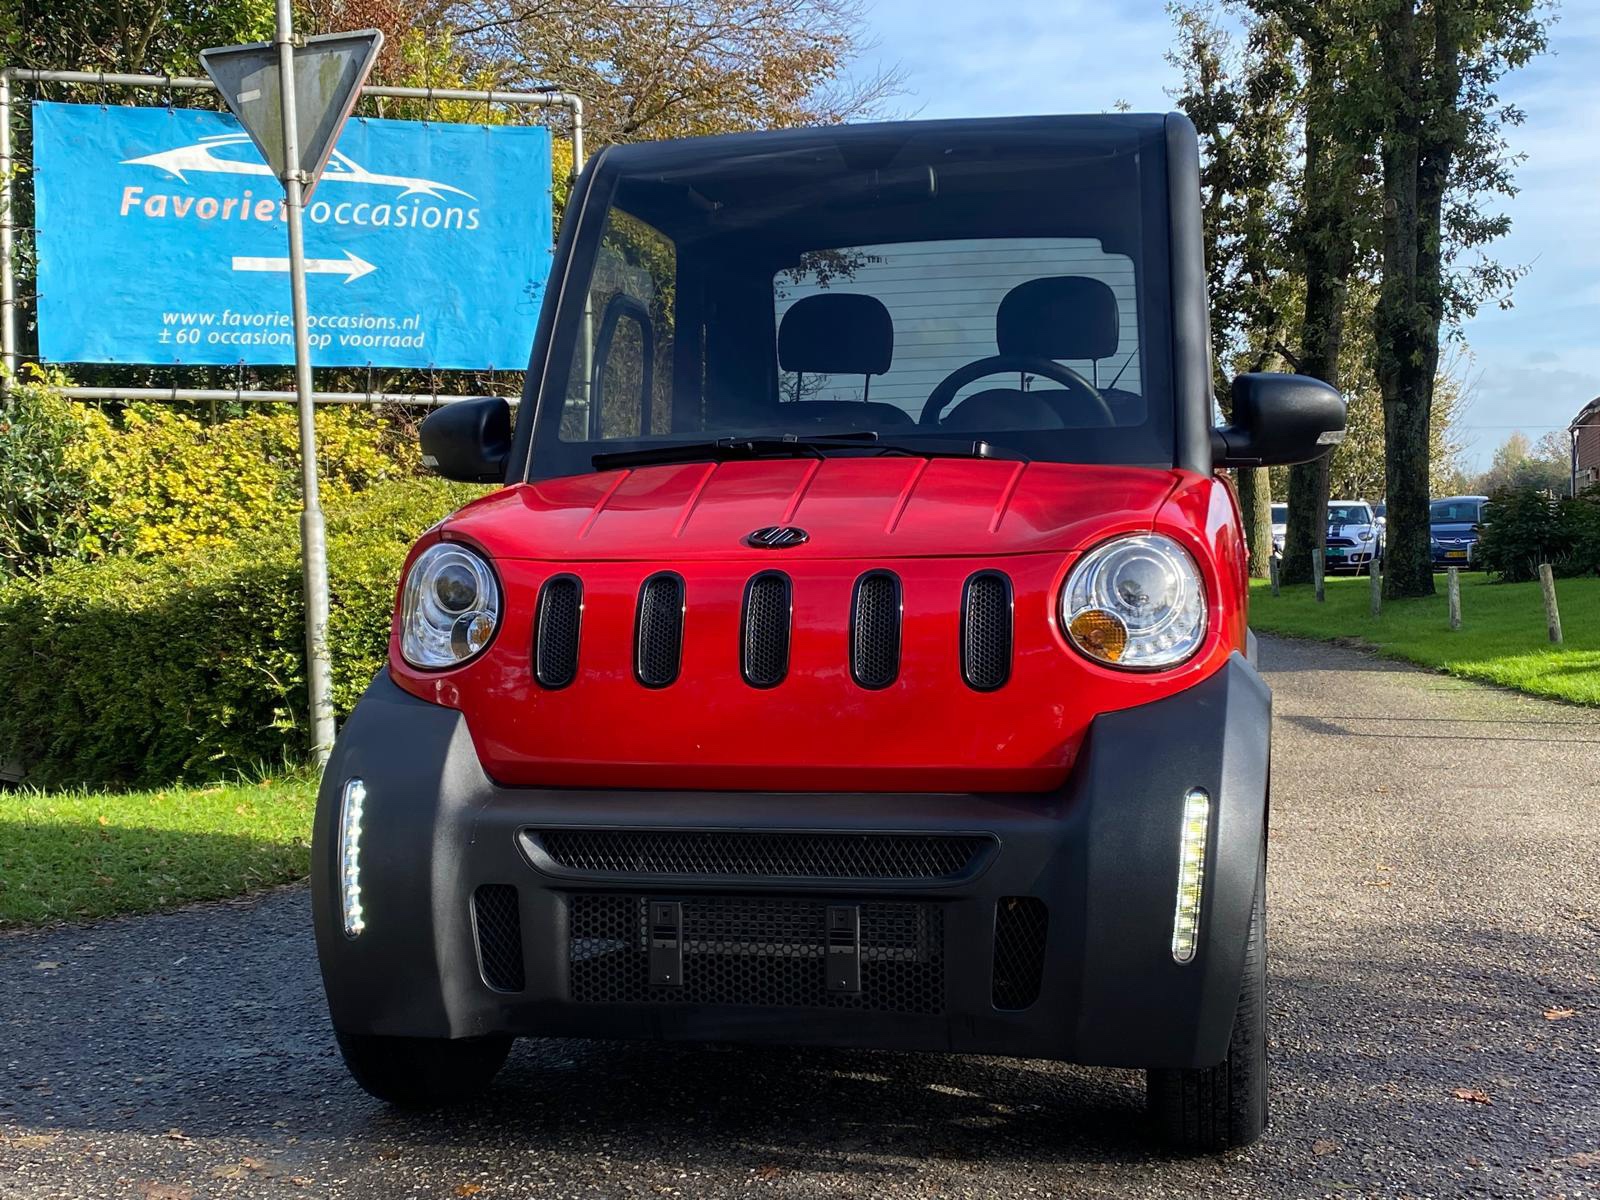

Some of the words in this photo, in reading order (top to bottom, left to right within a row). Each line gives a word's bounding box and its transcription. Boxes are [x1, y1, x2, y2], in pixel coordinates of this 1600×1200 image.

[161, 309, 421, 330] www.favorieoccasions.nl
[175, 328, 201, 345] 60
[207, 330, 295, 346] occasion
[307, 333, 332, 350] op
[339, 332, 425, 348] voorraad
